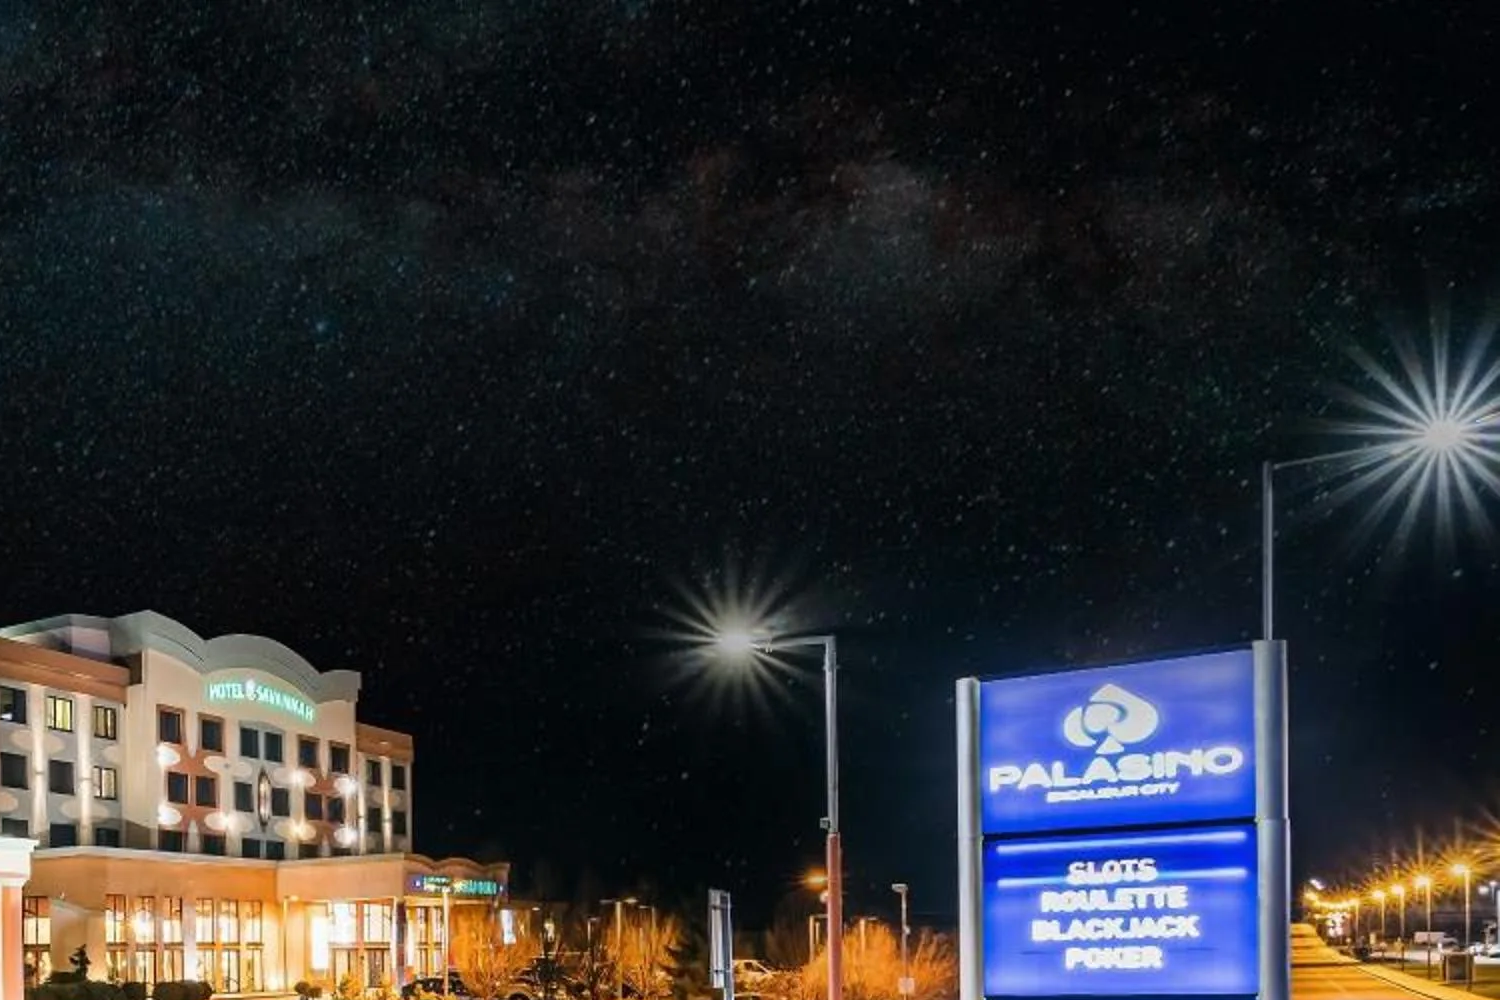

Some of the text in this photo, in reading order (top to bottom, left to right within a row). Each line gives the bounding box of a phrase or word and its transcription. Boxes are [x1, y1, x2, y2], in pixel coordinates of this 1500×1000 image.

[208, 682, 245, 700] HOTEL
[989, 746, 1244, 793] PALASINO
[1066, 858, 1158, 885] SLOTS
[1041, 886, 1189, 912] ROULETTE
[1031, 915, 1201, 941] BLACKJACK
[1065, 946, 1164, 970] POKER
